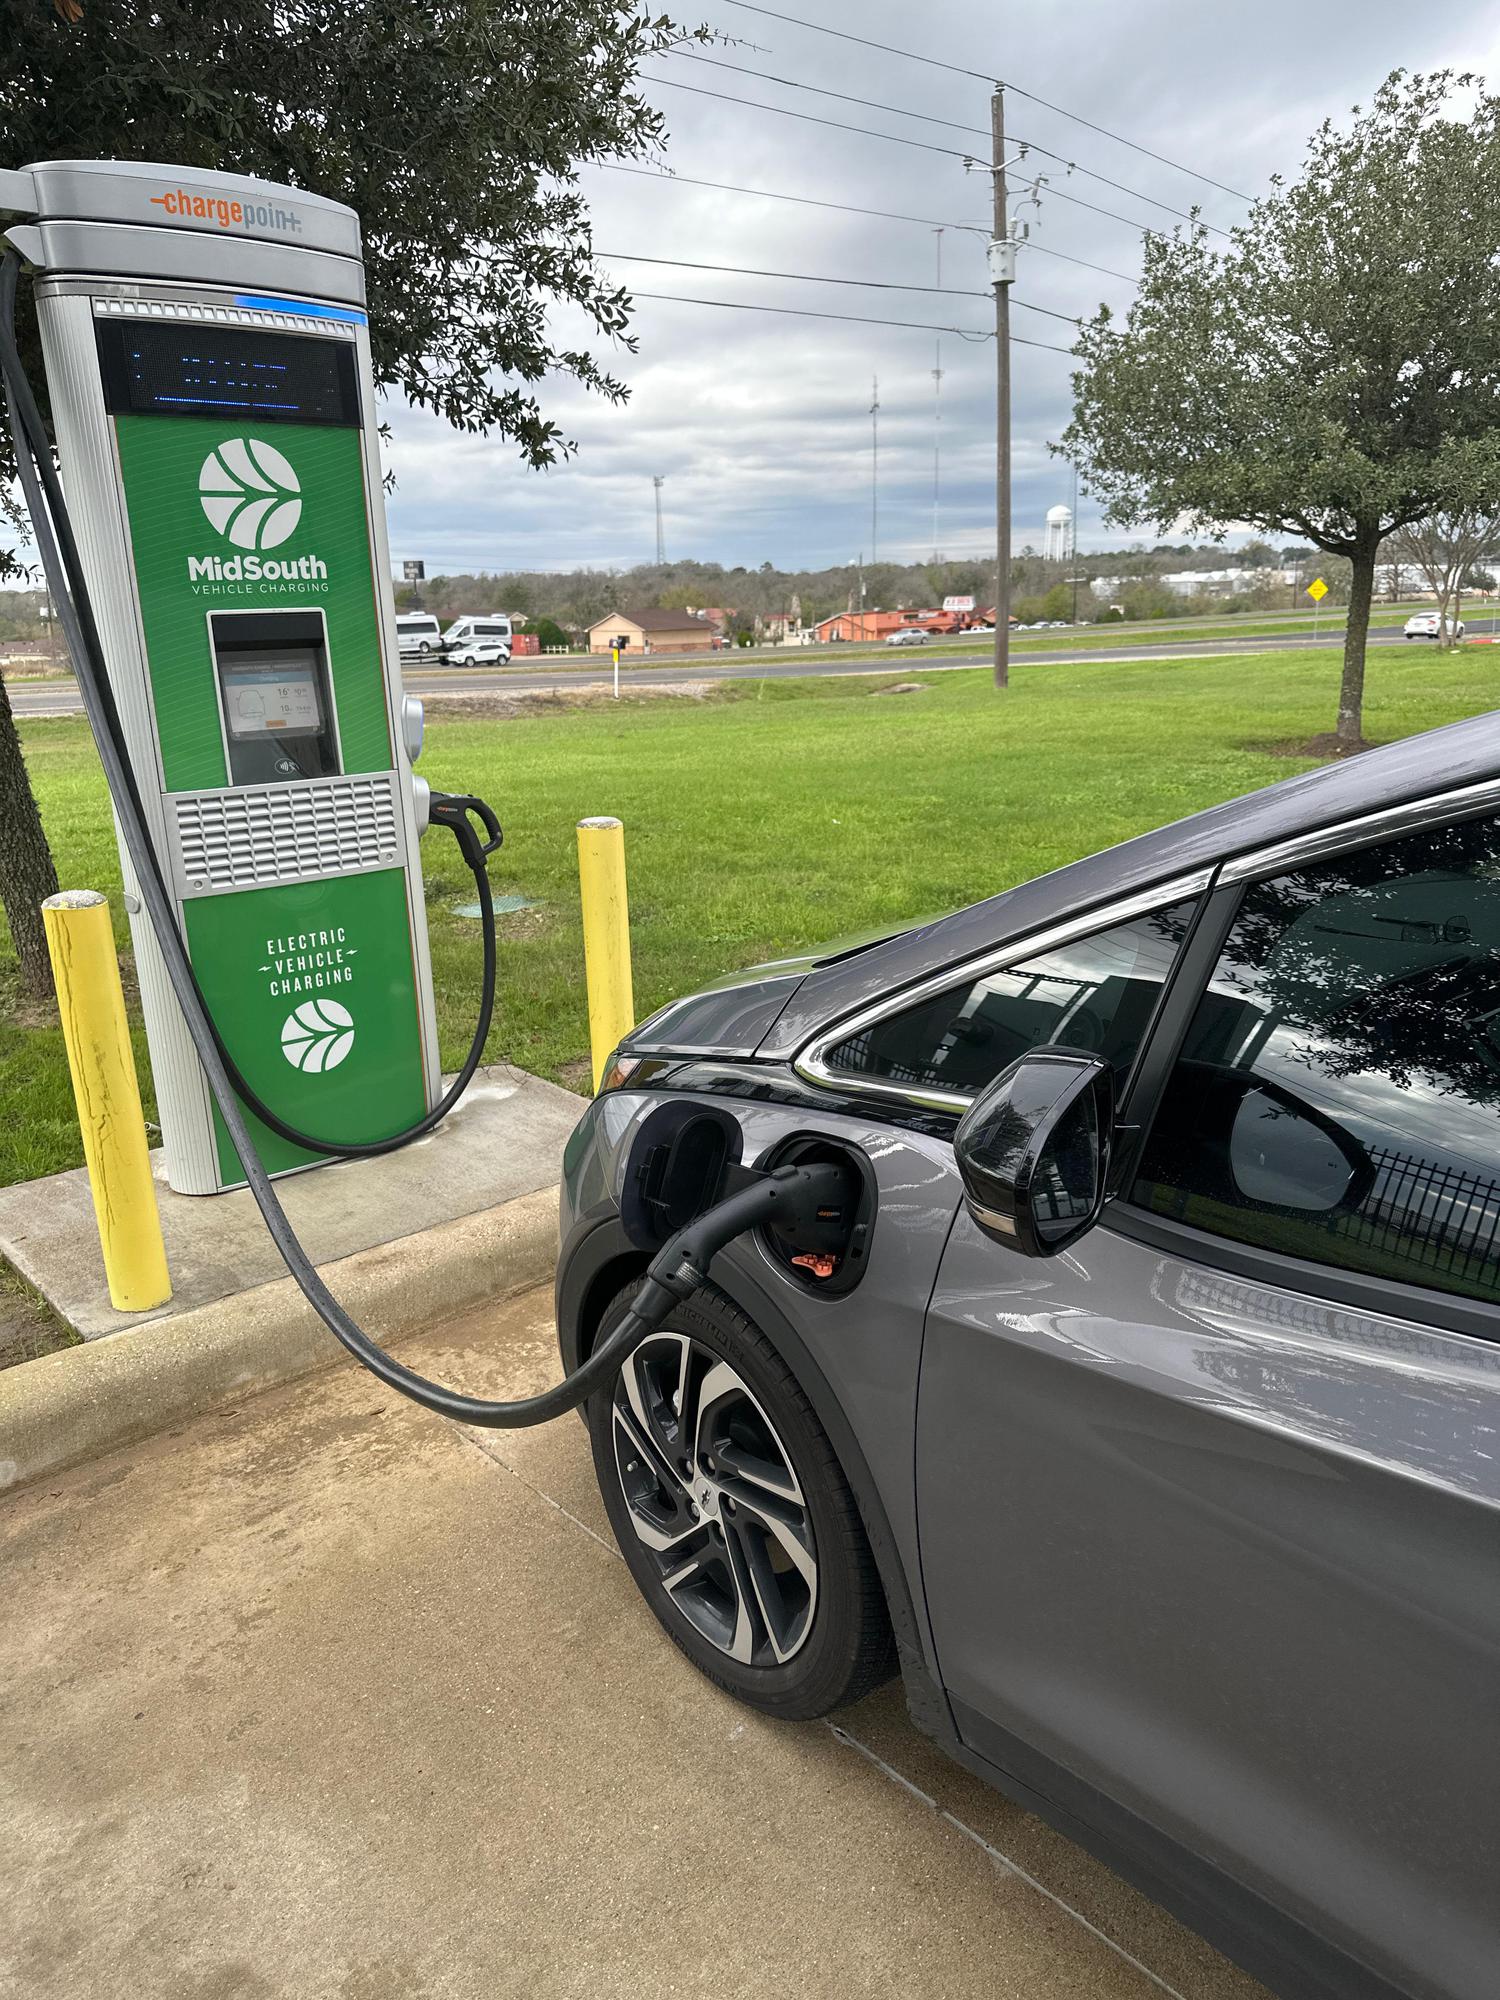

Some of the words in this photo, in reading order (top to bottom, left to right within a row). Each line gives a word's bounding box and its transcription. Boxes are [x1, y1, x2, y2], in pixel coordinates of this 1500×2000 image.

[151, 189, 301, 232] chargepoint
[187, 555, 328, 581] MidSouth
[191, 584, 253, 595] VEHICLE
[259, 582, 329, 594] CHARGING
[267, 927, 345, 955] ELECTRIC
[275, 949, 344, 975] VEHICLE
[270, 966, 352, 996] CHARGING
